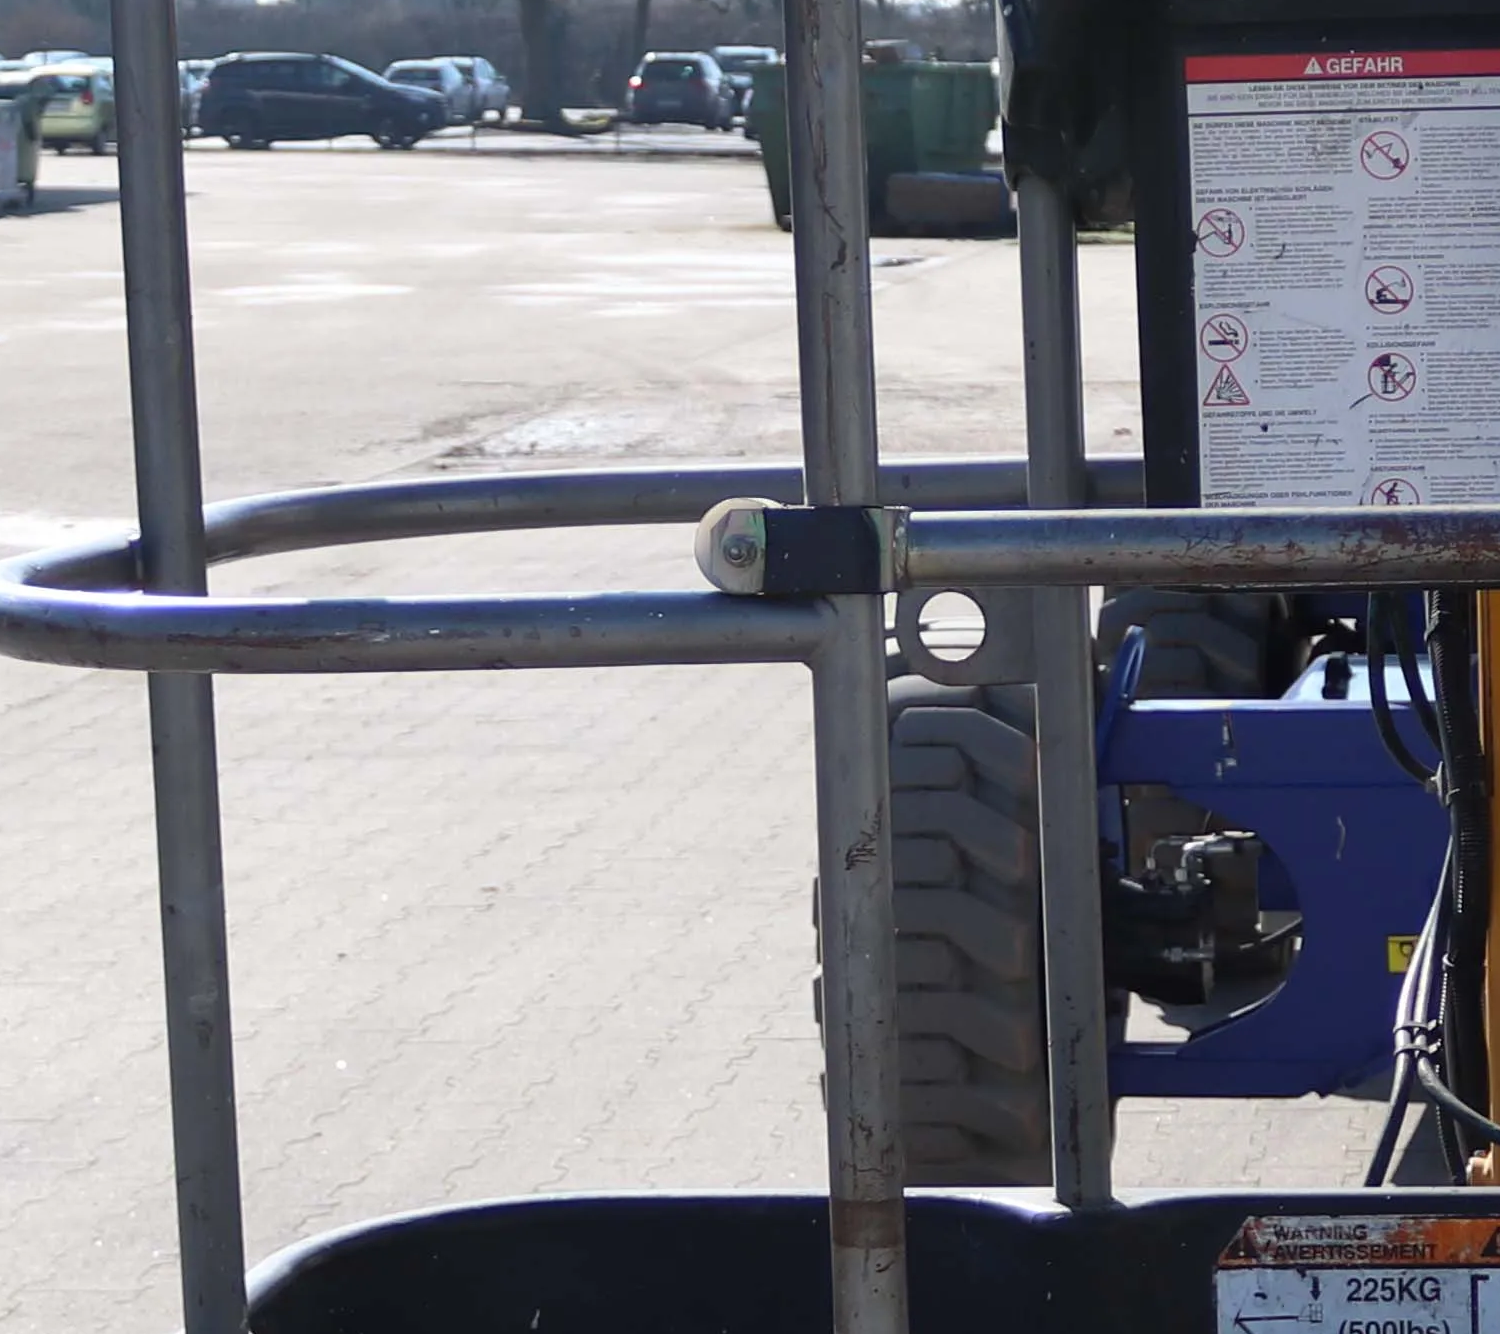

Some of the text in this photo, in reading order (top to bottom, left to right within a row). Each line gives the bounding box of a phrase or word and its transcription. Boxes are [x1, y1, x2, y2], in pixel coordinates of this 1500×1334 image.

[1326, 56, 1403, 74] GEFAHR
[1273, 1224, 1368, 1241] WARNING
[1274, 1243, 1439, 1260] AVERTISSEMENT
[1346, 1276, 1442, 1303] 225KG
